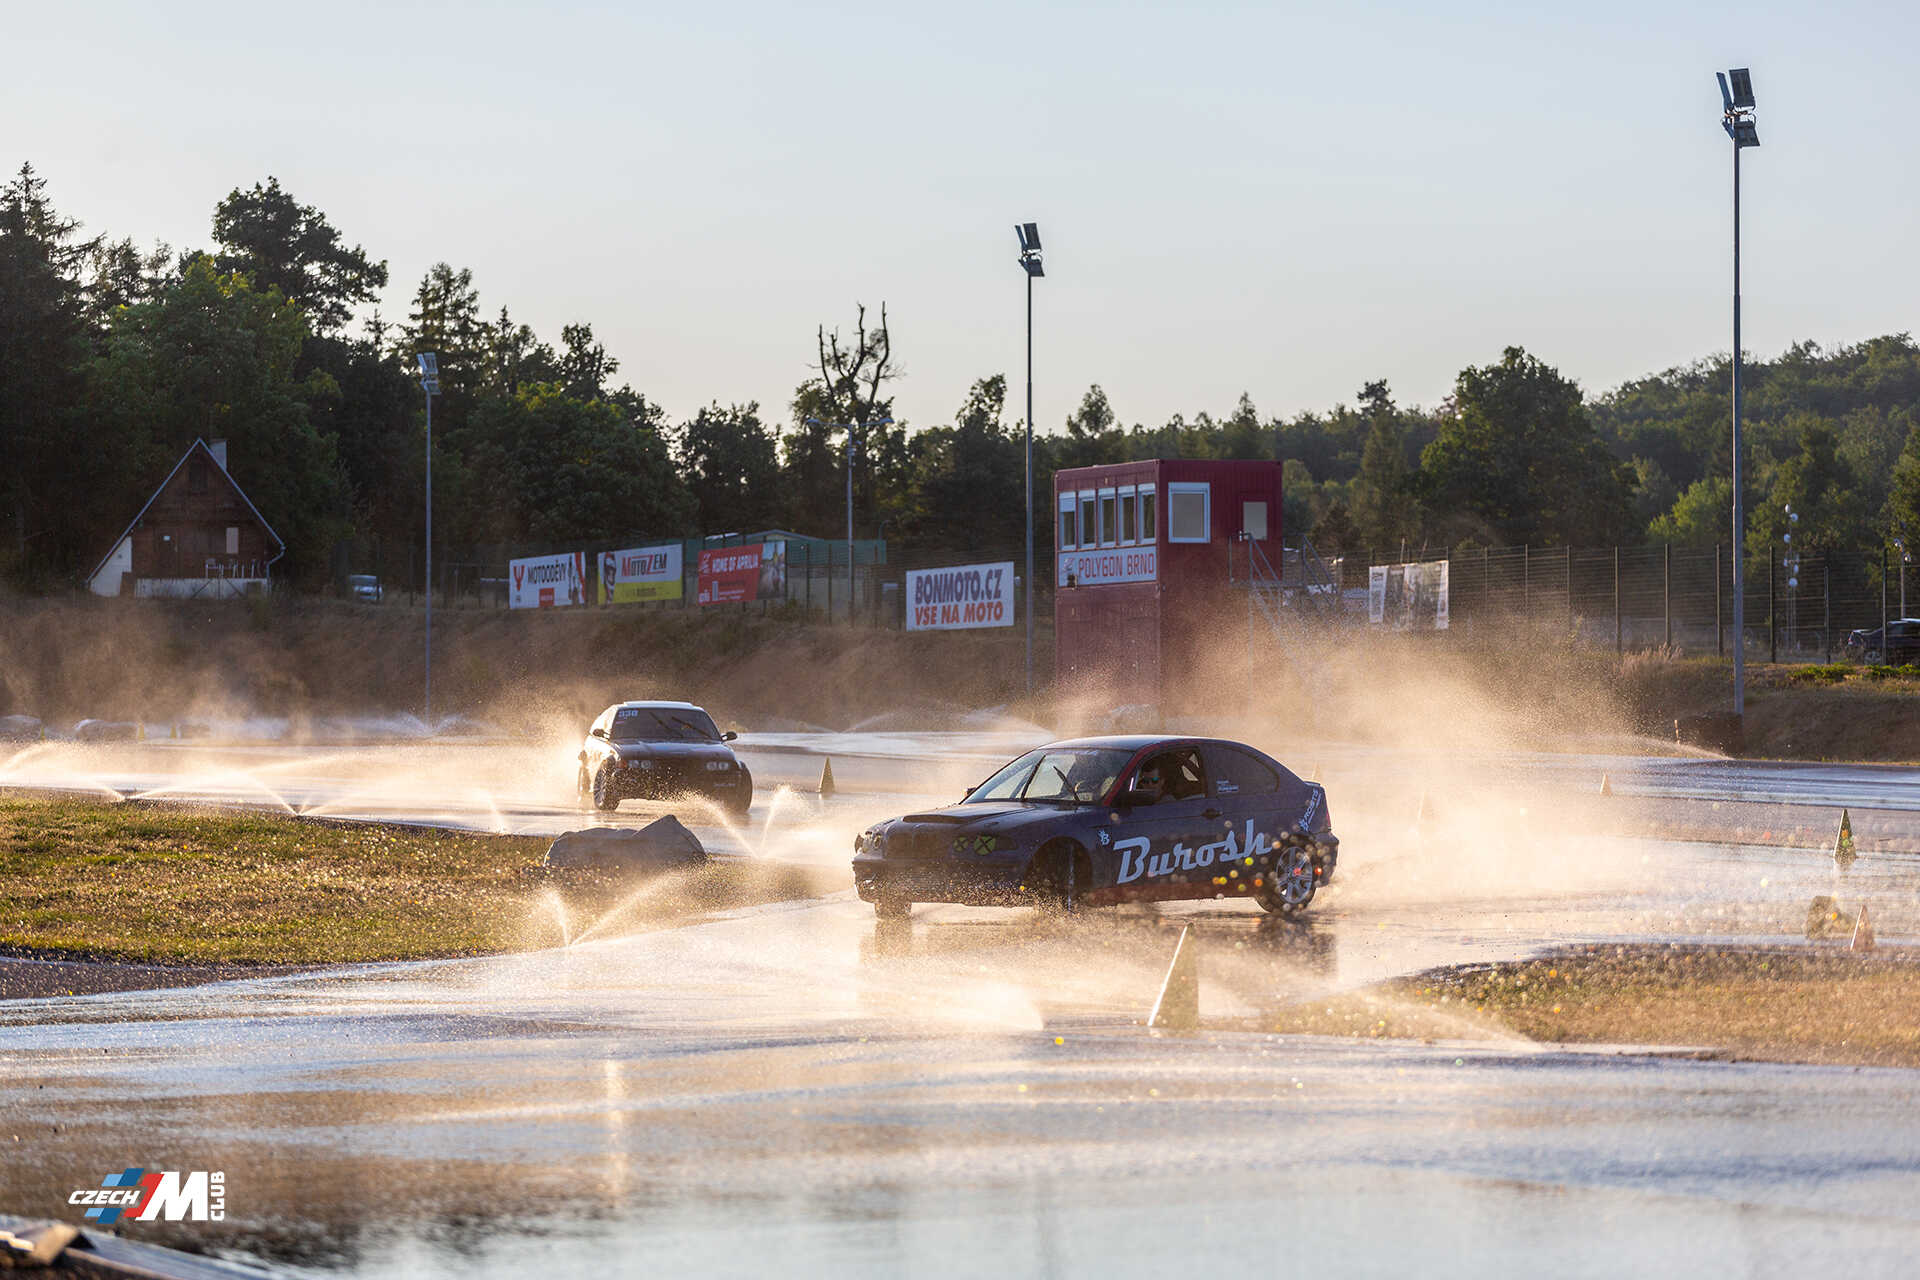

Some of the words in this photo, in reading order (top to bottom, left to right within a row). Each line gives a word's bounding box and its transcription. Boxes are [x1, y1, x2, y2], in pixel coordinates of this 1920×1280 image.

[1078, 555, 1123, 578] POLYGON
[1127, 553, 1155, 576] BRNO
[915, 568, 1003, 605] BONMOTO.CZ
[915, 605, 938, 626] VSE
[941, 603, 960, 625] NA
[963, 600, 1004, 624] MOTO
[1113, 818, 1273, 885] Burosh
